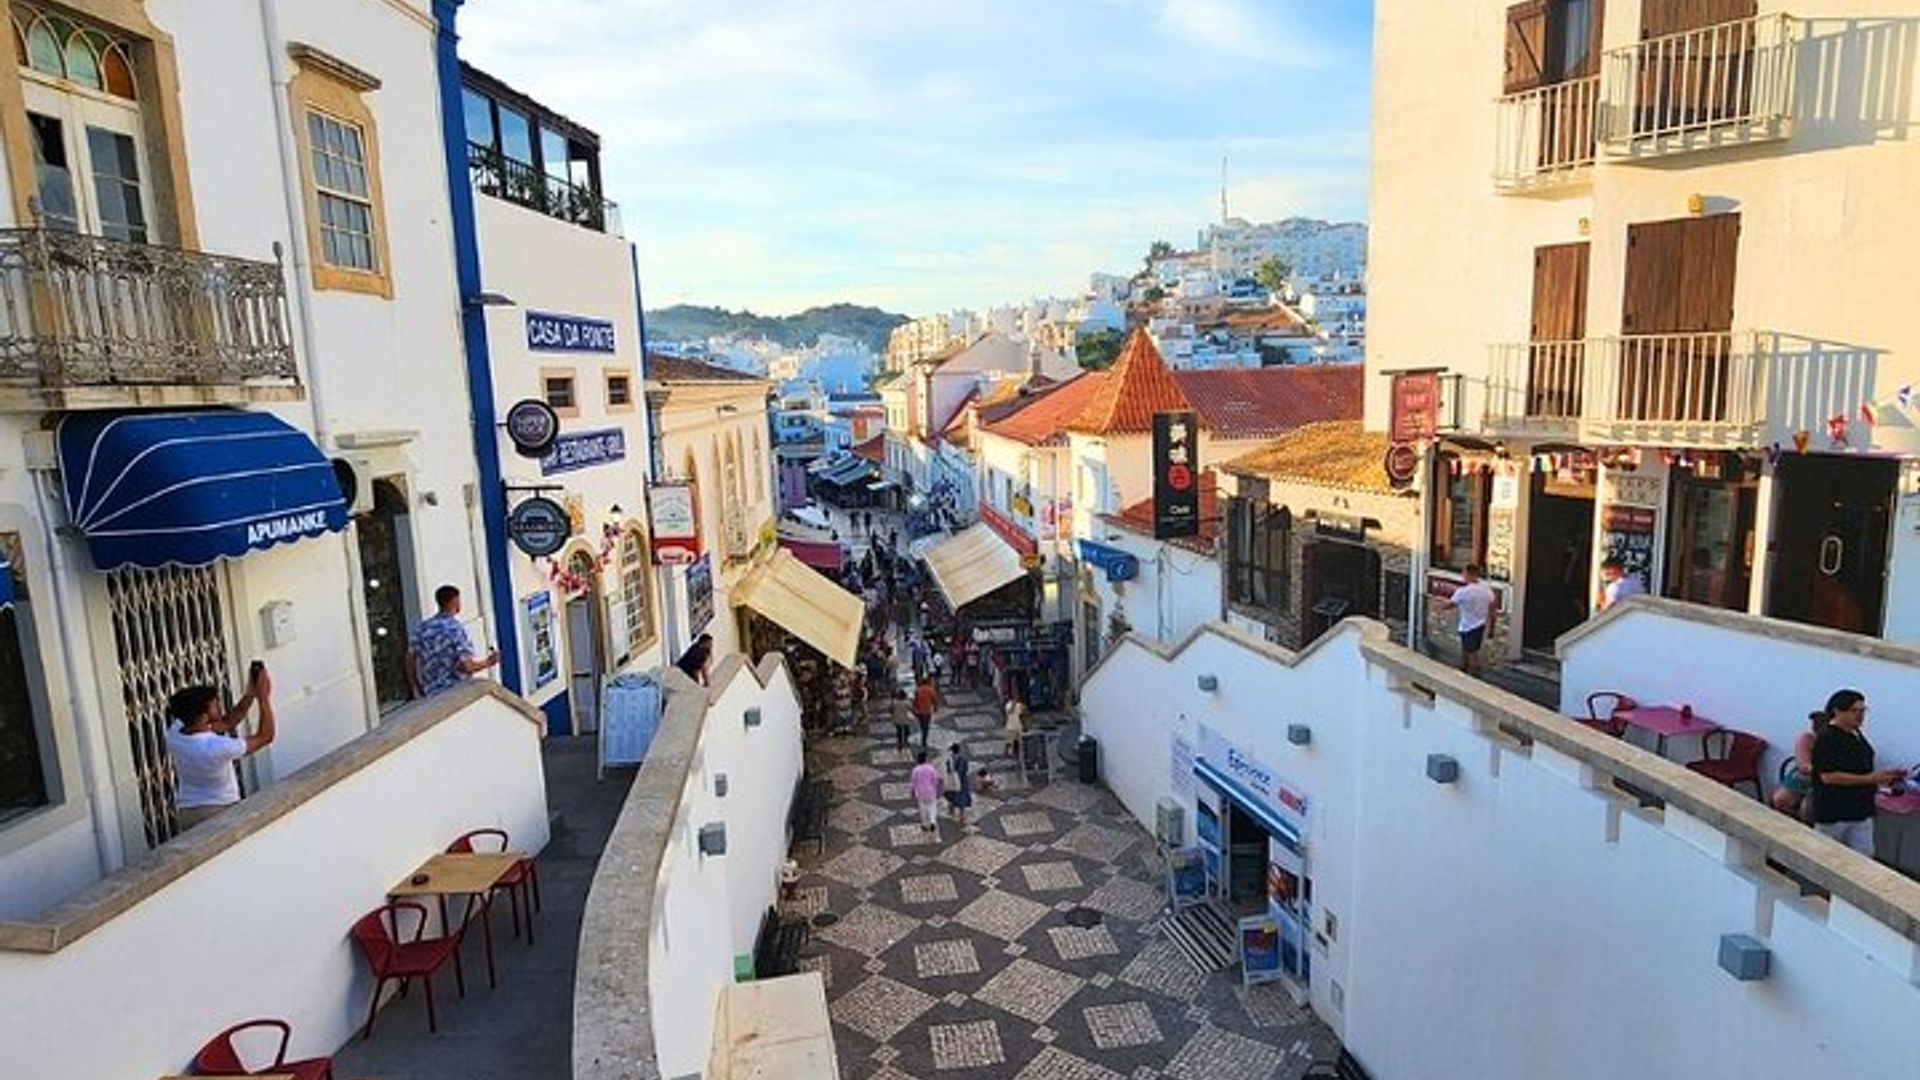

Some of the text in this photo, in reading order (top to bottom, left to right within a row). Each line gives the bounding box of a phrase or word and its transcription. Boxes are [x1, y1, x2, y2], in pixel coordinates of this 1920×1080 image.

[530, 319, 614, 350] CASA DA FONTE
[247, 510, 327, 545] APUMANKE
